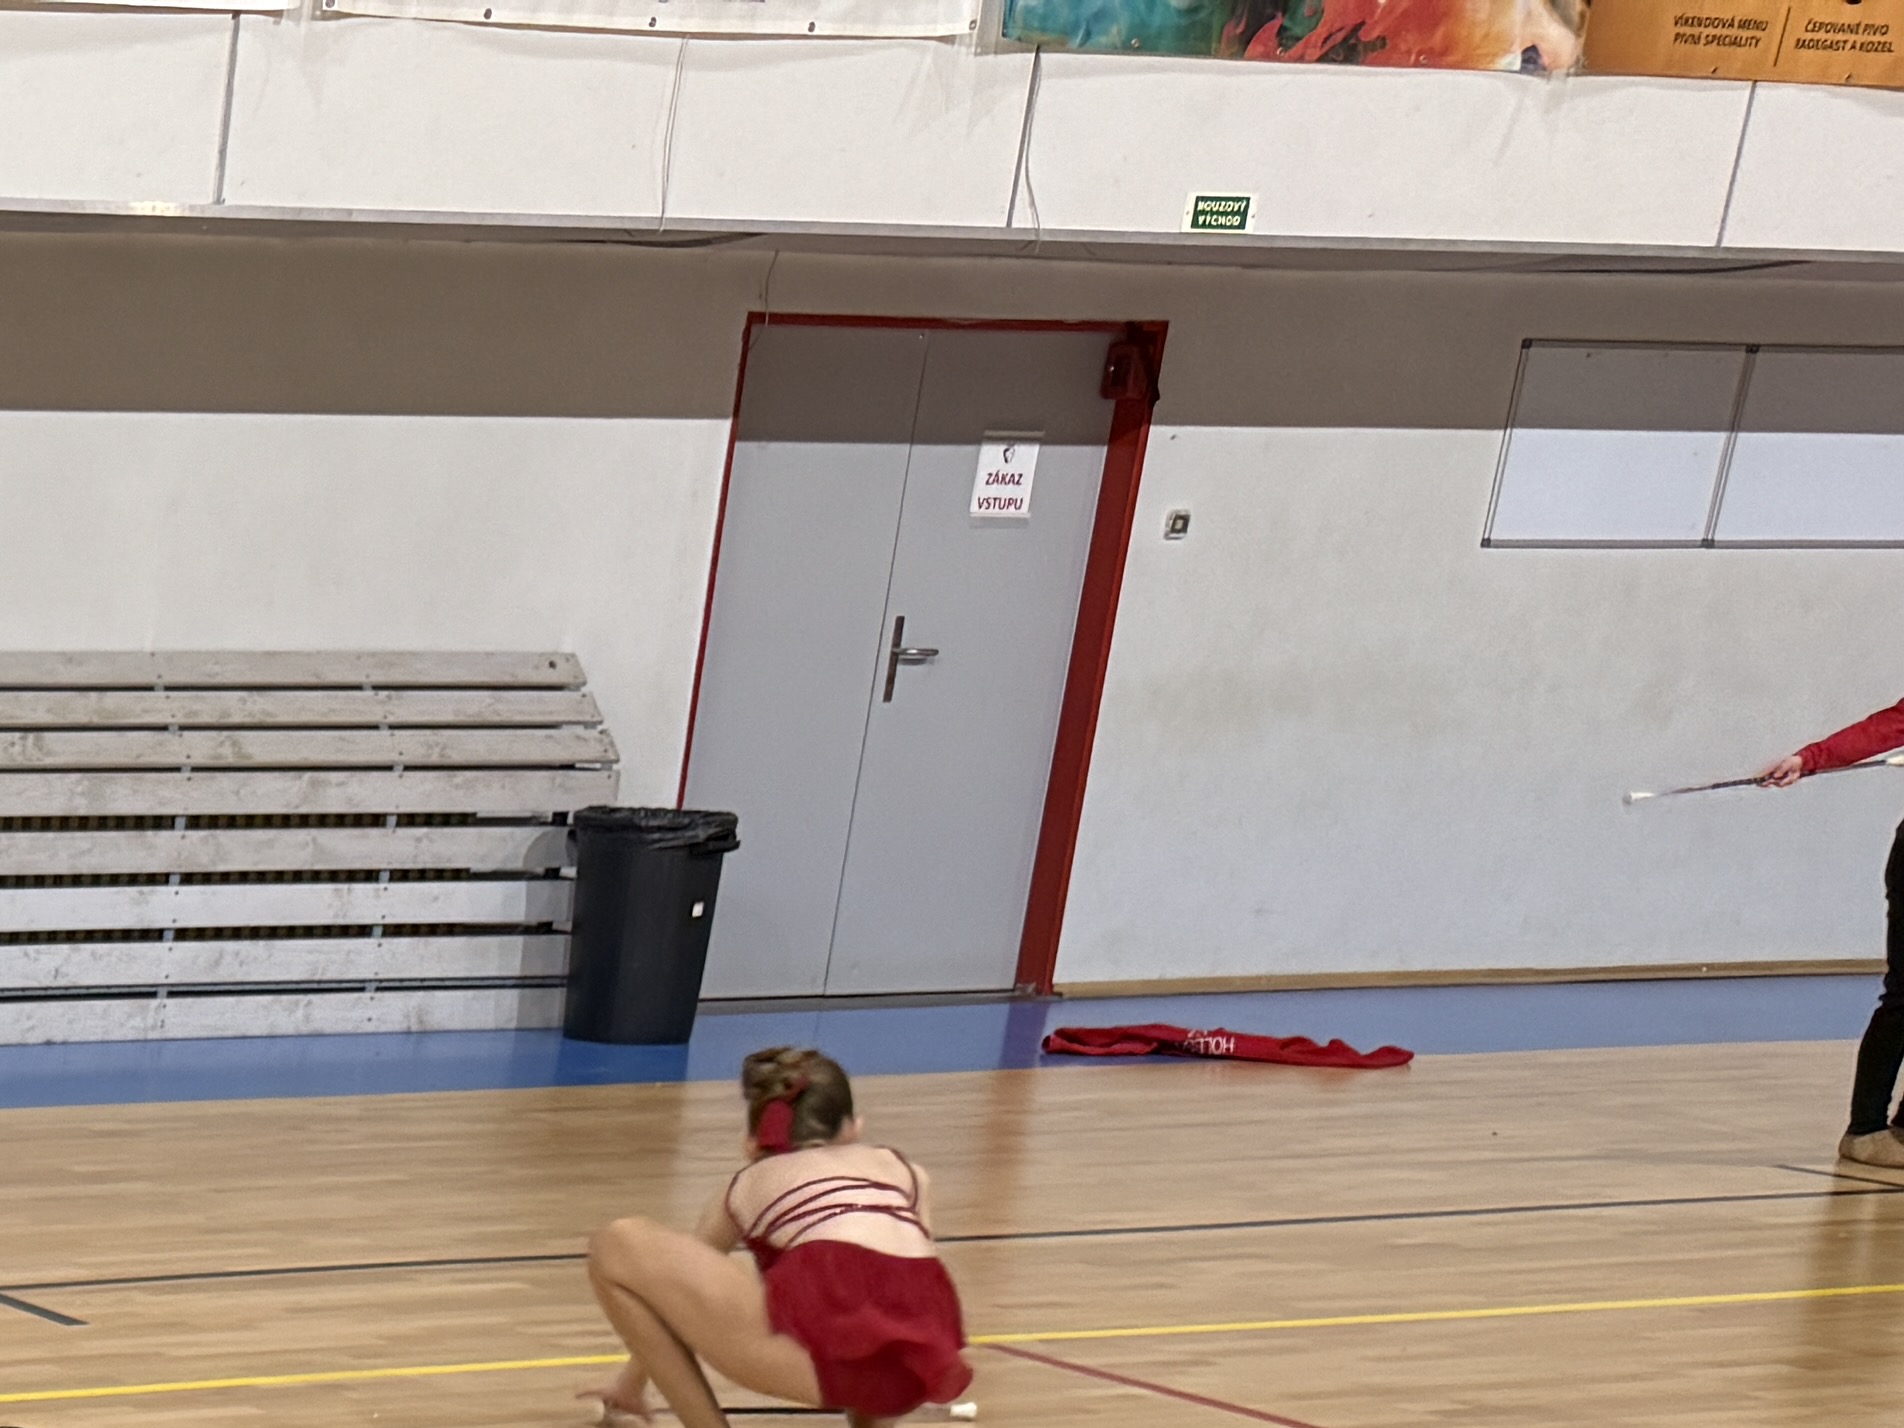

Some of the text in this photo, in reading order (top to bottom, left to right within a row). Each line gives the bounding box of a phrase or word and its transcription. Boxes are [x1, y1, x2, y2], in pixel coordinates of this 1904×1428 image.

[1861, 22, 1890, 37] PIVO
[1702, 32, 1762, 49] SPECIALITY
[1858, 40, 1895, 54] KOZEL
[1196, 199, 1247, 213] NOUZOVÝ
[1197, 213, 1242, 227] VÝCHOD
[985, 469, 1024, 486] ZÁKAZ
[977, 496, 1024, 511] VSTUPU
